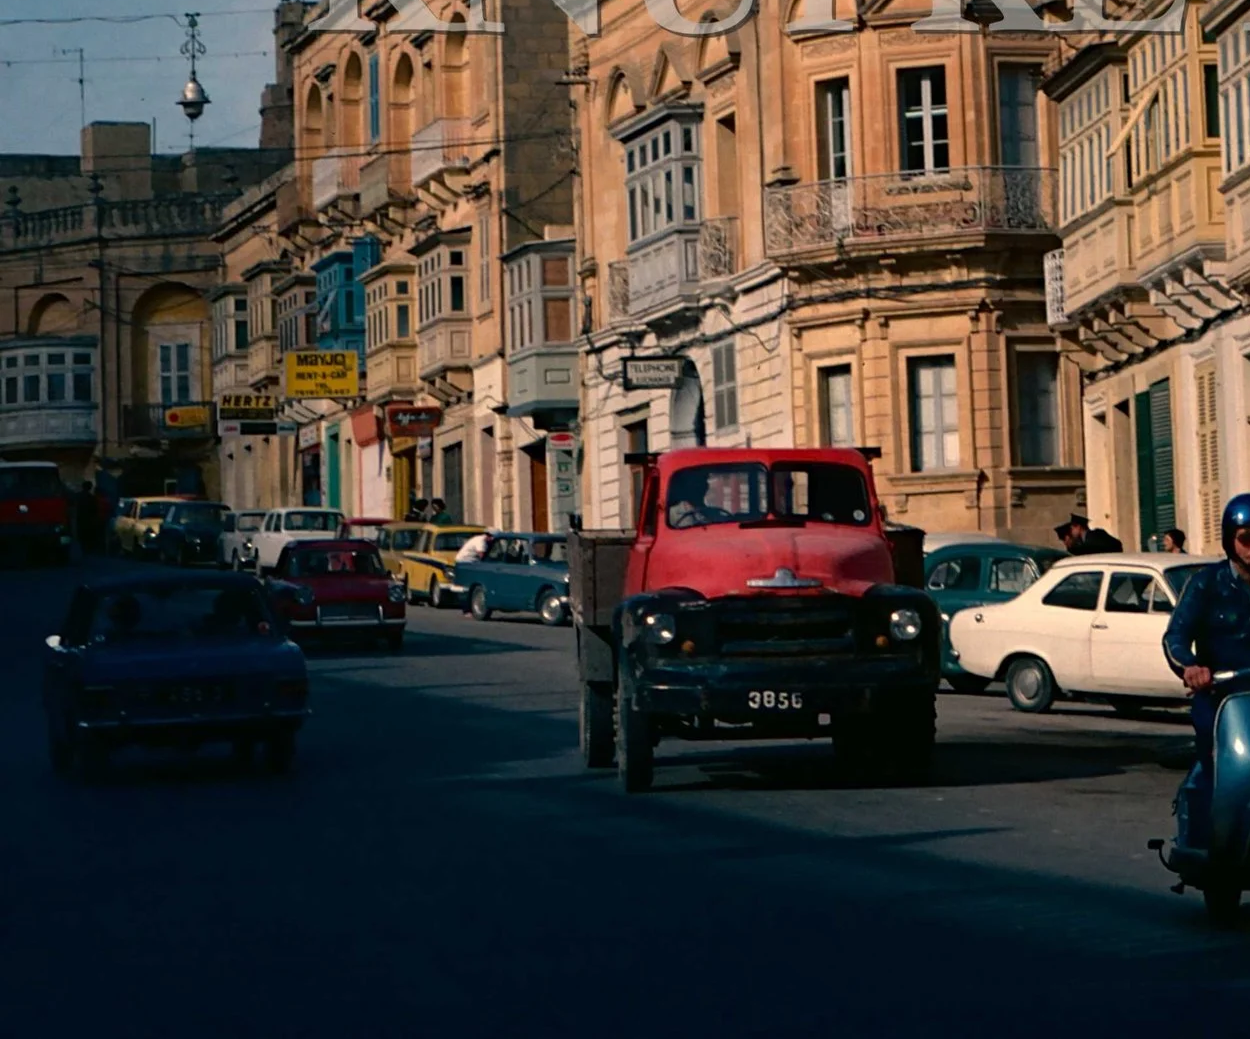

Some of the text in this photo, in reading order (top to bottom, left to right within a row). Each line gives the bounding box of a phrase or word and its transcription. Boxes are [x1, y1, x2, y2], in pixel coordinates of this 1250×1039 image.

[630, 363, 676, 373] TELEPHONE
[222, 395, 272, 407] HERTZ
[748, 690, 803, 710] 3856
